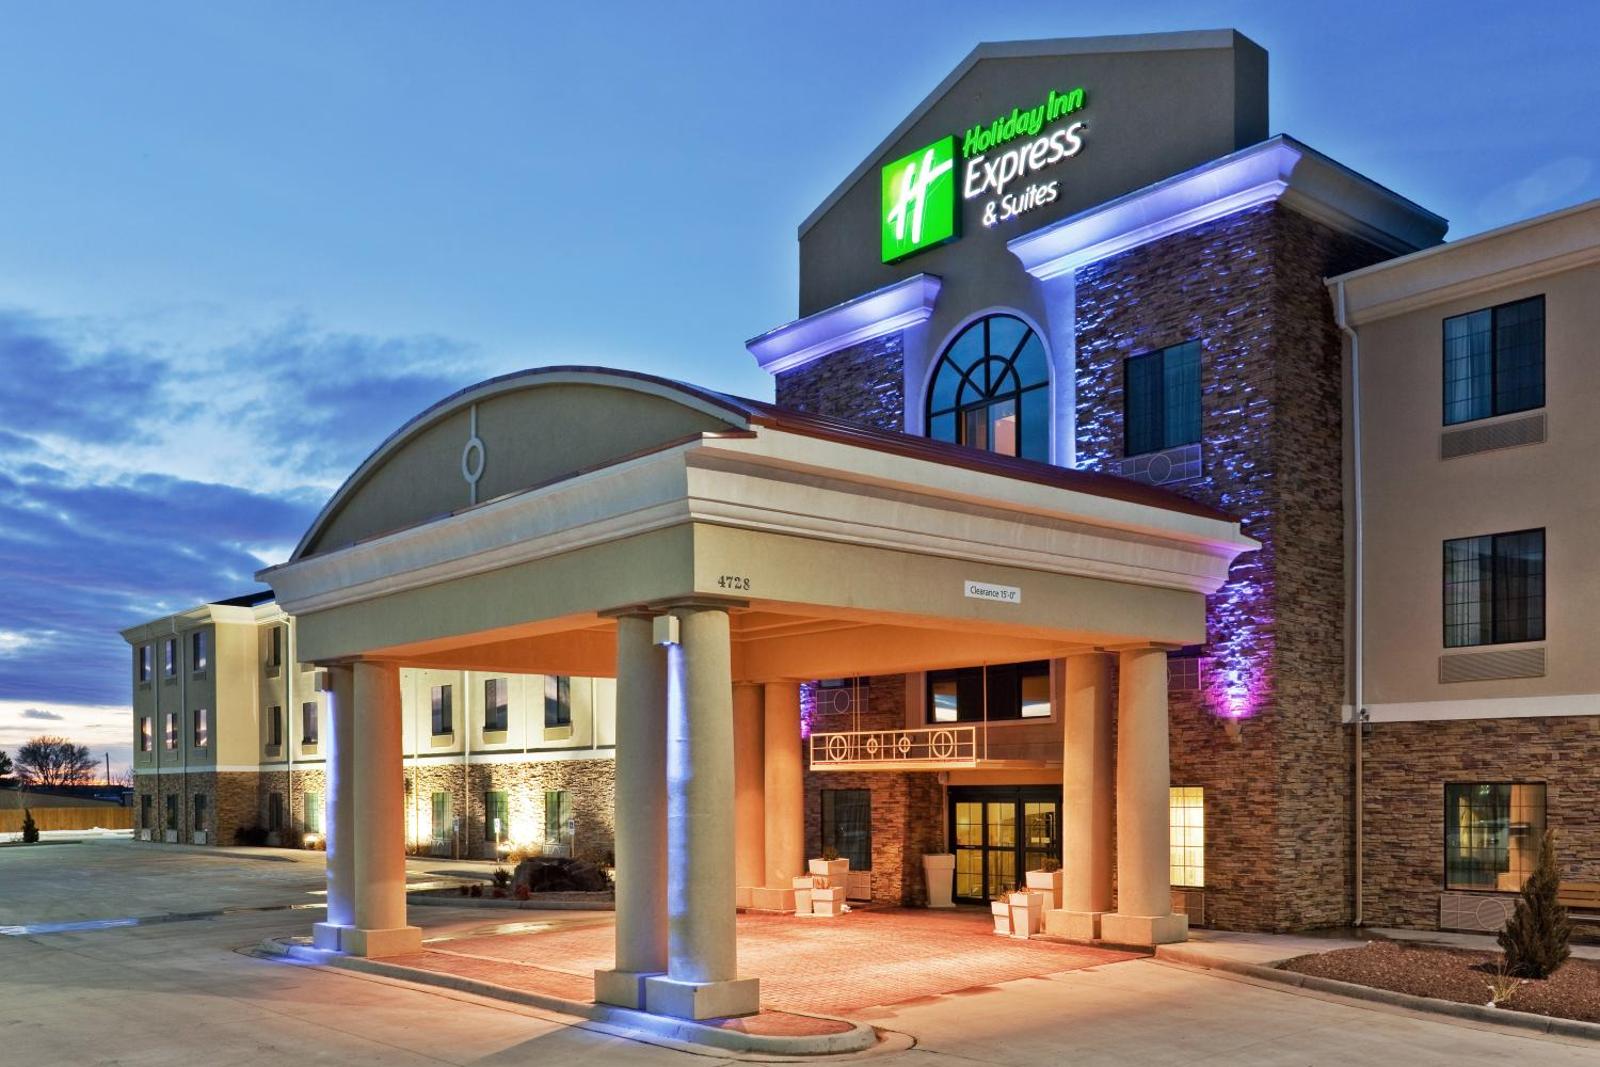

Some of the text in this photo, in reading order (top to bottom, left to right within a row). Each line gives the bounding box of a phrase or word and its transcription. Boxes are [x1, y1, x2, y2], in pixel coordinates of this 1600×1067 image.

[963, 88, 1084, 158] Holiday Inn
[964, 122, 1082, 199] Express
[982, 181, 1058, 226] & Suites
[717, 575, 751, 591] 4728
[970, 585, 999, 598] Clearance
